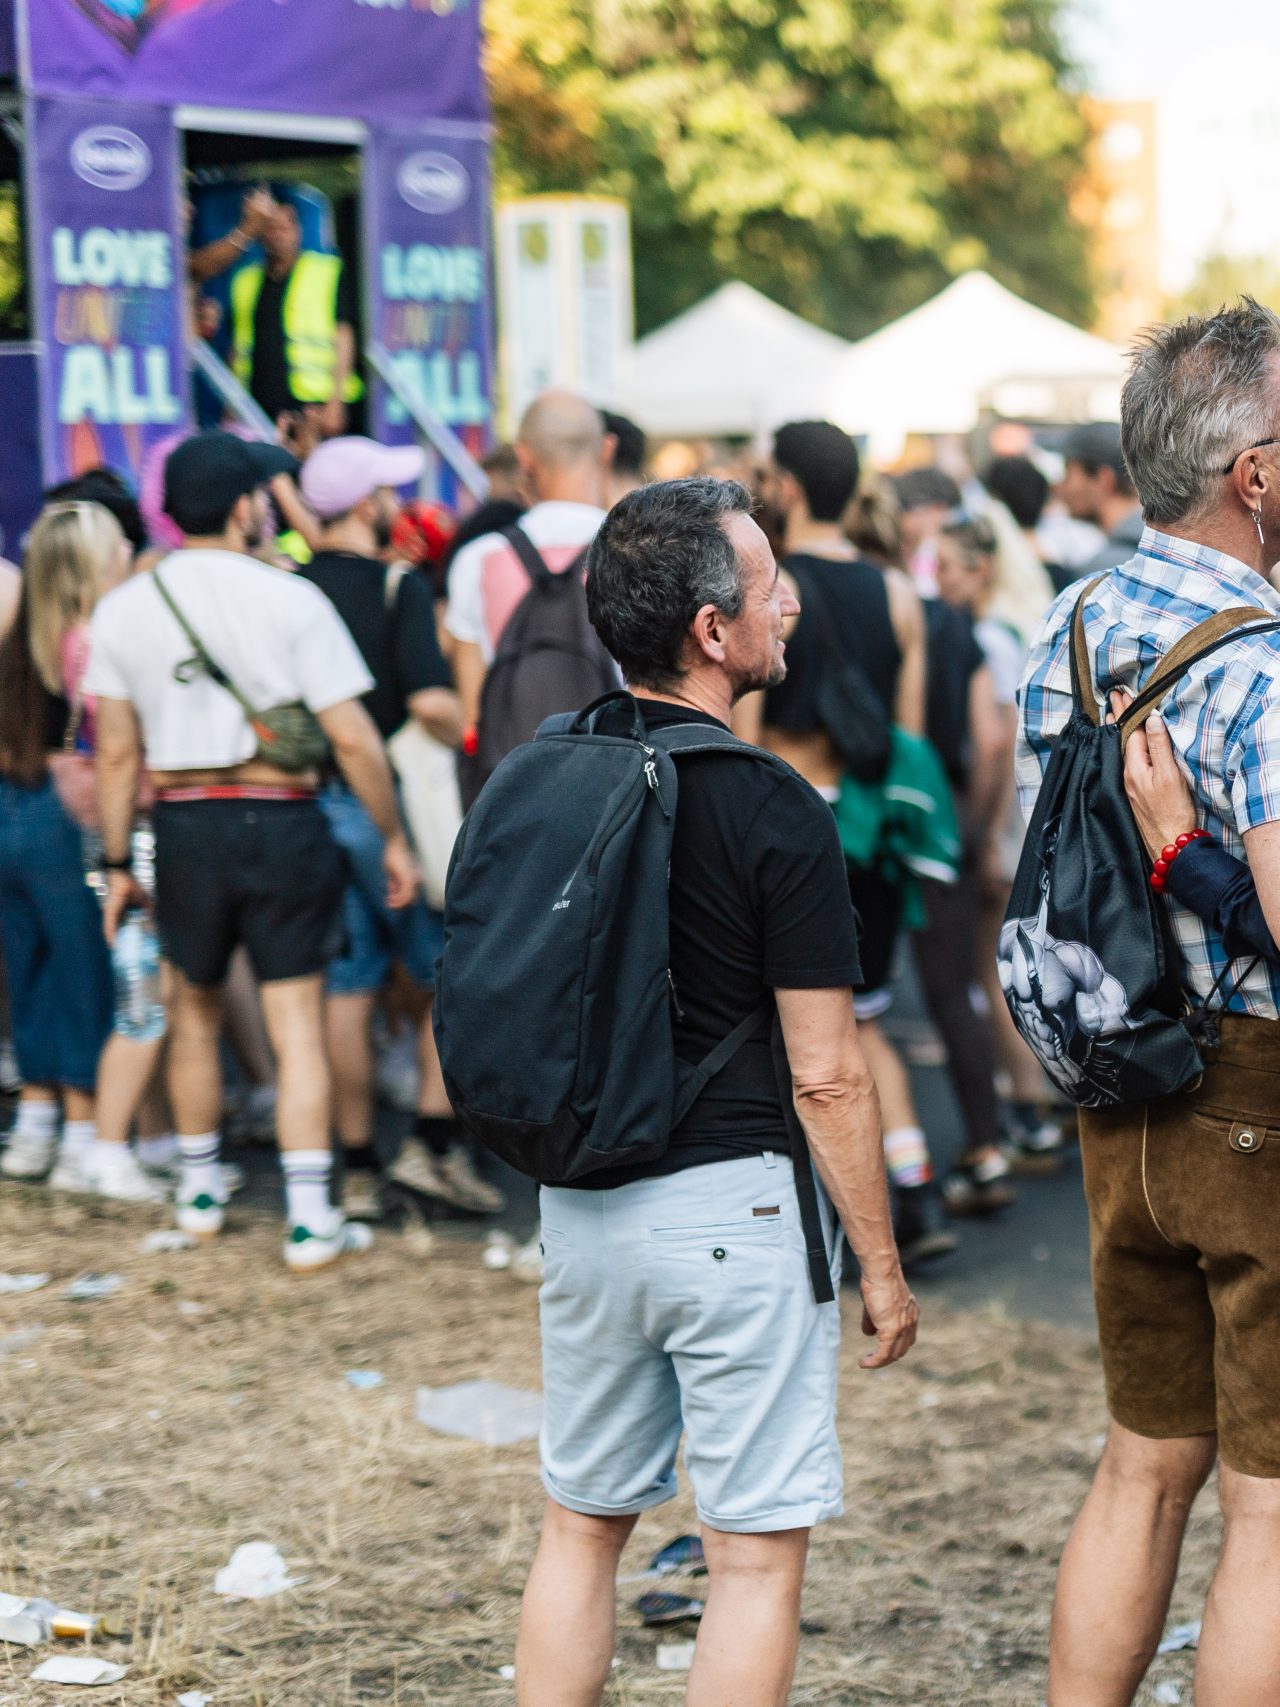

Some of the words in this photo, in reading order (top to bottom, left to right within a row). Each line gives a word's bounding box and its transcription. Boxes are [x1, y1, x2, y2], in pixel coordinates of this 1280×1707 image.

[53, 227, 171, 287] LOVE
[382, 244, 482, 302] LOVE
[59, 346, 180, 424] ALL
